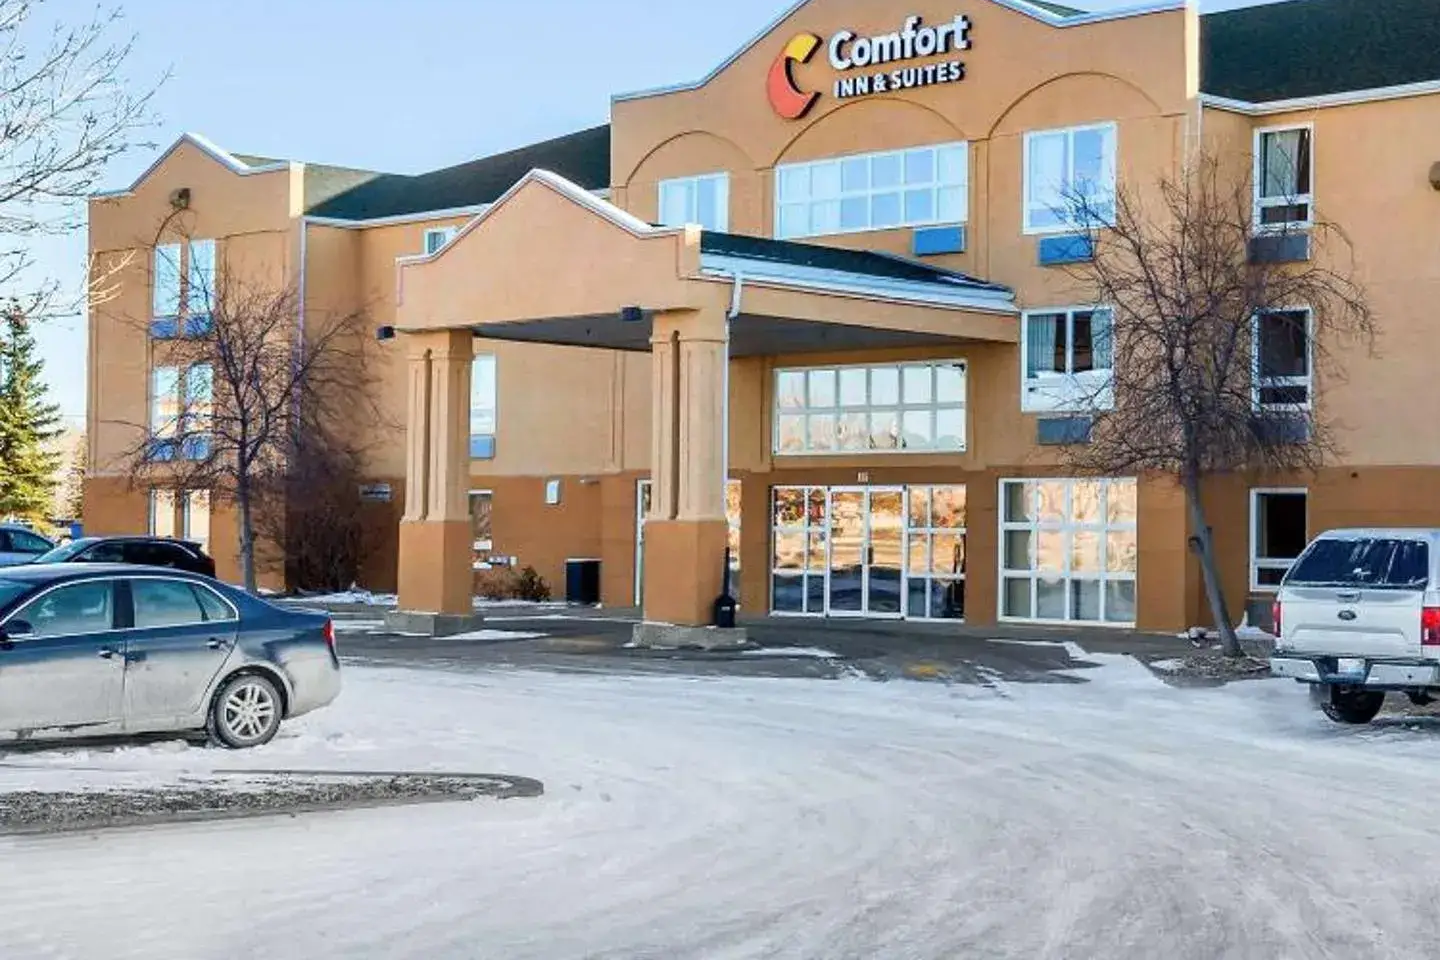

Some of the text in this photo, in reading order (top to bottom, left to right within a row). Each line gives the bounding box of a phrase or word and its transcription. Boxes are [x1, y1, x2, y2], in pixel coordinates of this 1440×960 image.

[829, 14, 969, 70] Comfort
[833, 61, 963, 98] INN & SUITES
